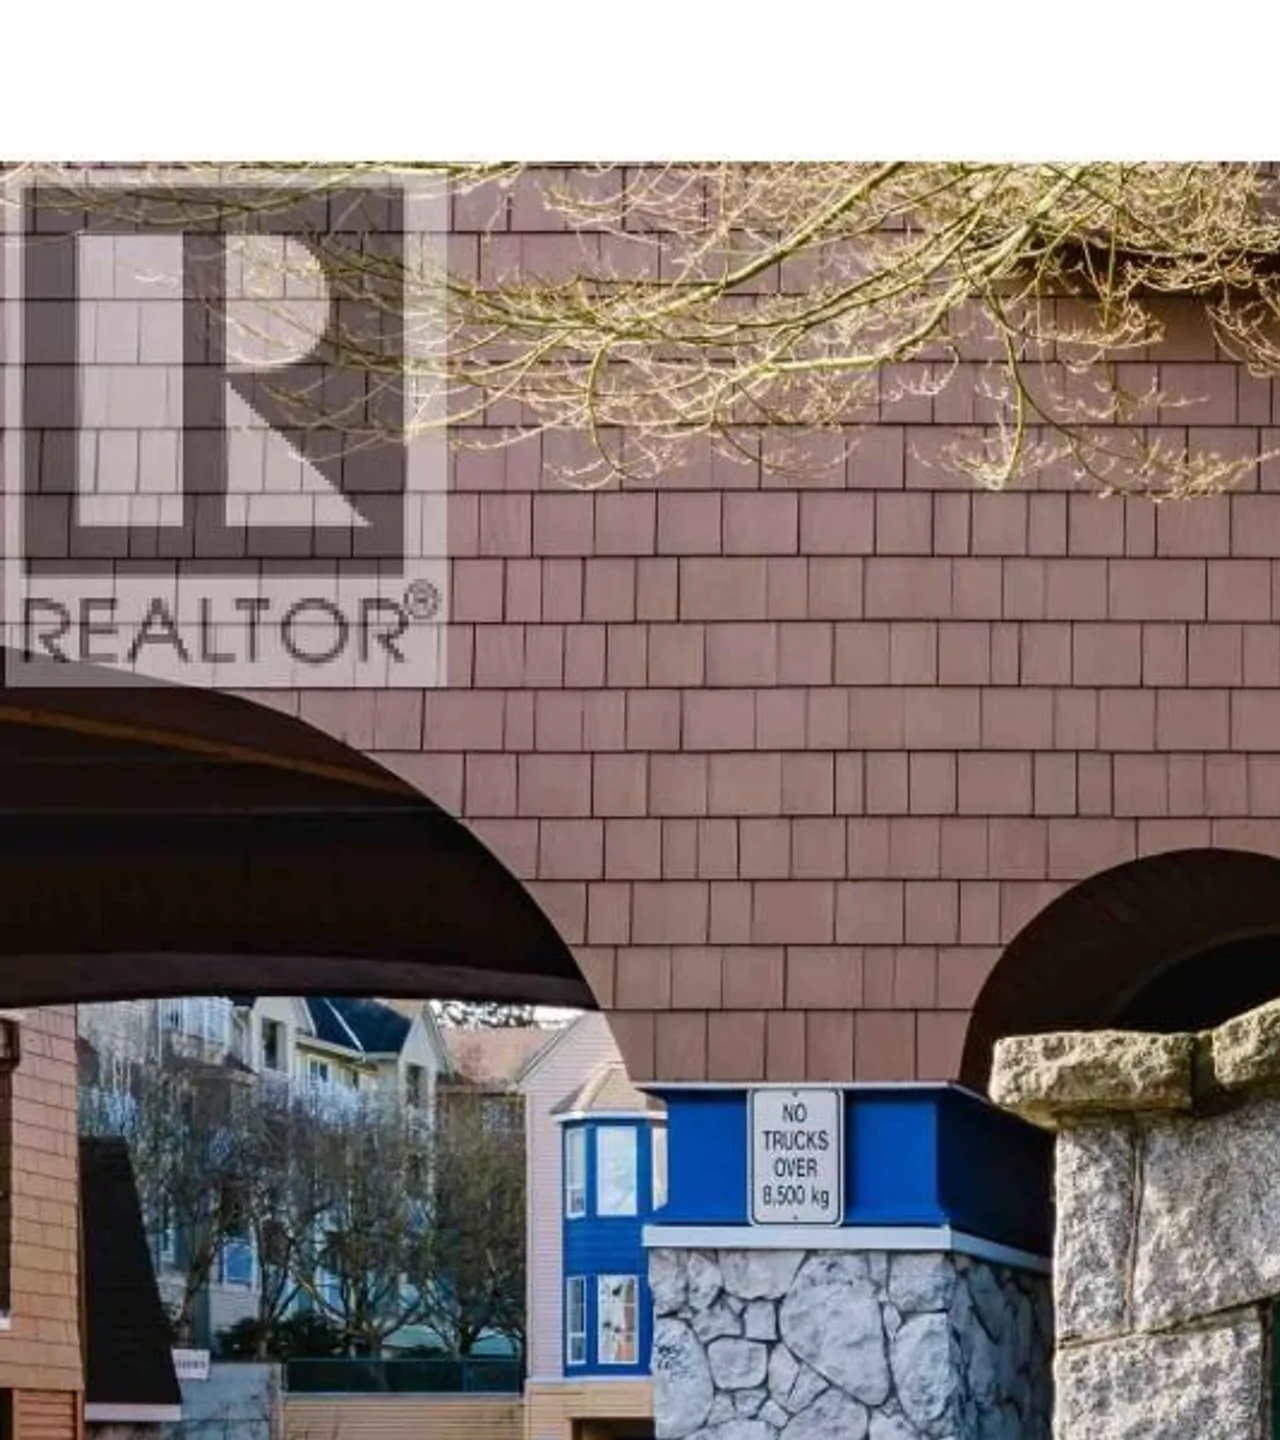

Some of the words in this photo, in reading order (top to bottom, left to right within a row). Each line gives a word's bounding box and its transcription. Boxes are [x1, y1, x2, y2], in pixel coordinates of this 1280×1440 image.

[782, 1103, 807, 1122] NO
[762, 1130, 830, 1151] TRUCKS
[773, 1157, 818, 1178] OVER
[811, 1184, 830, 1210] kg
